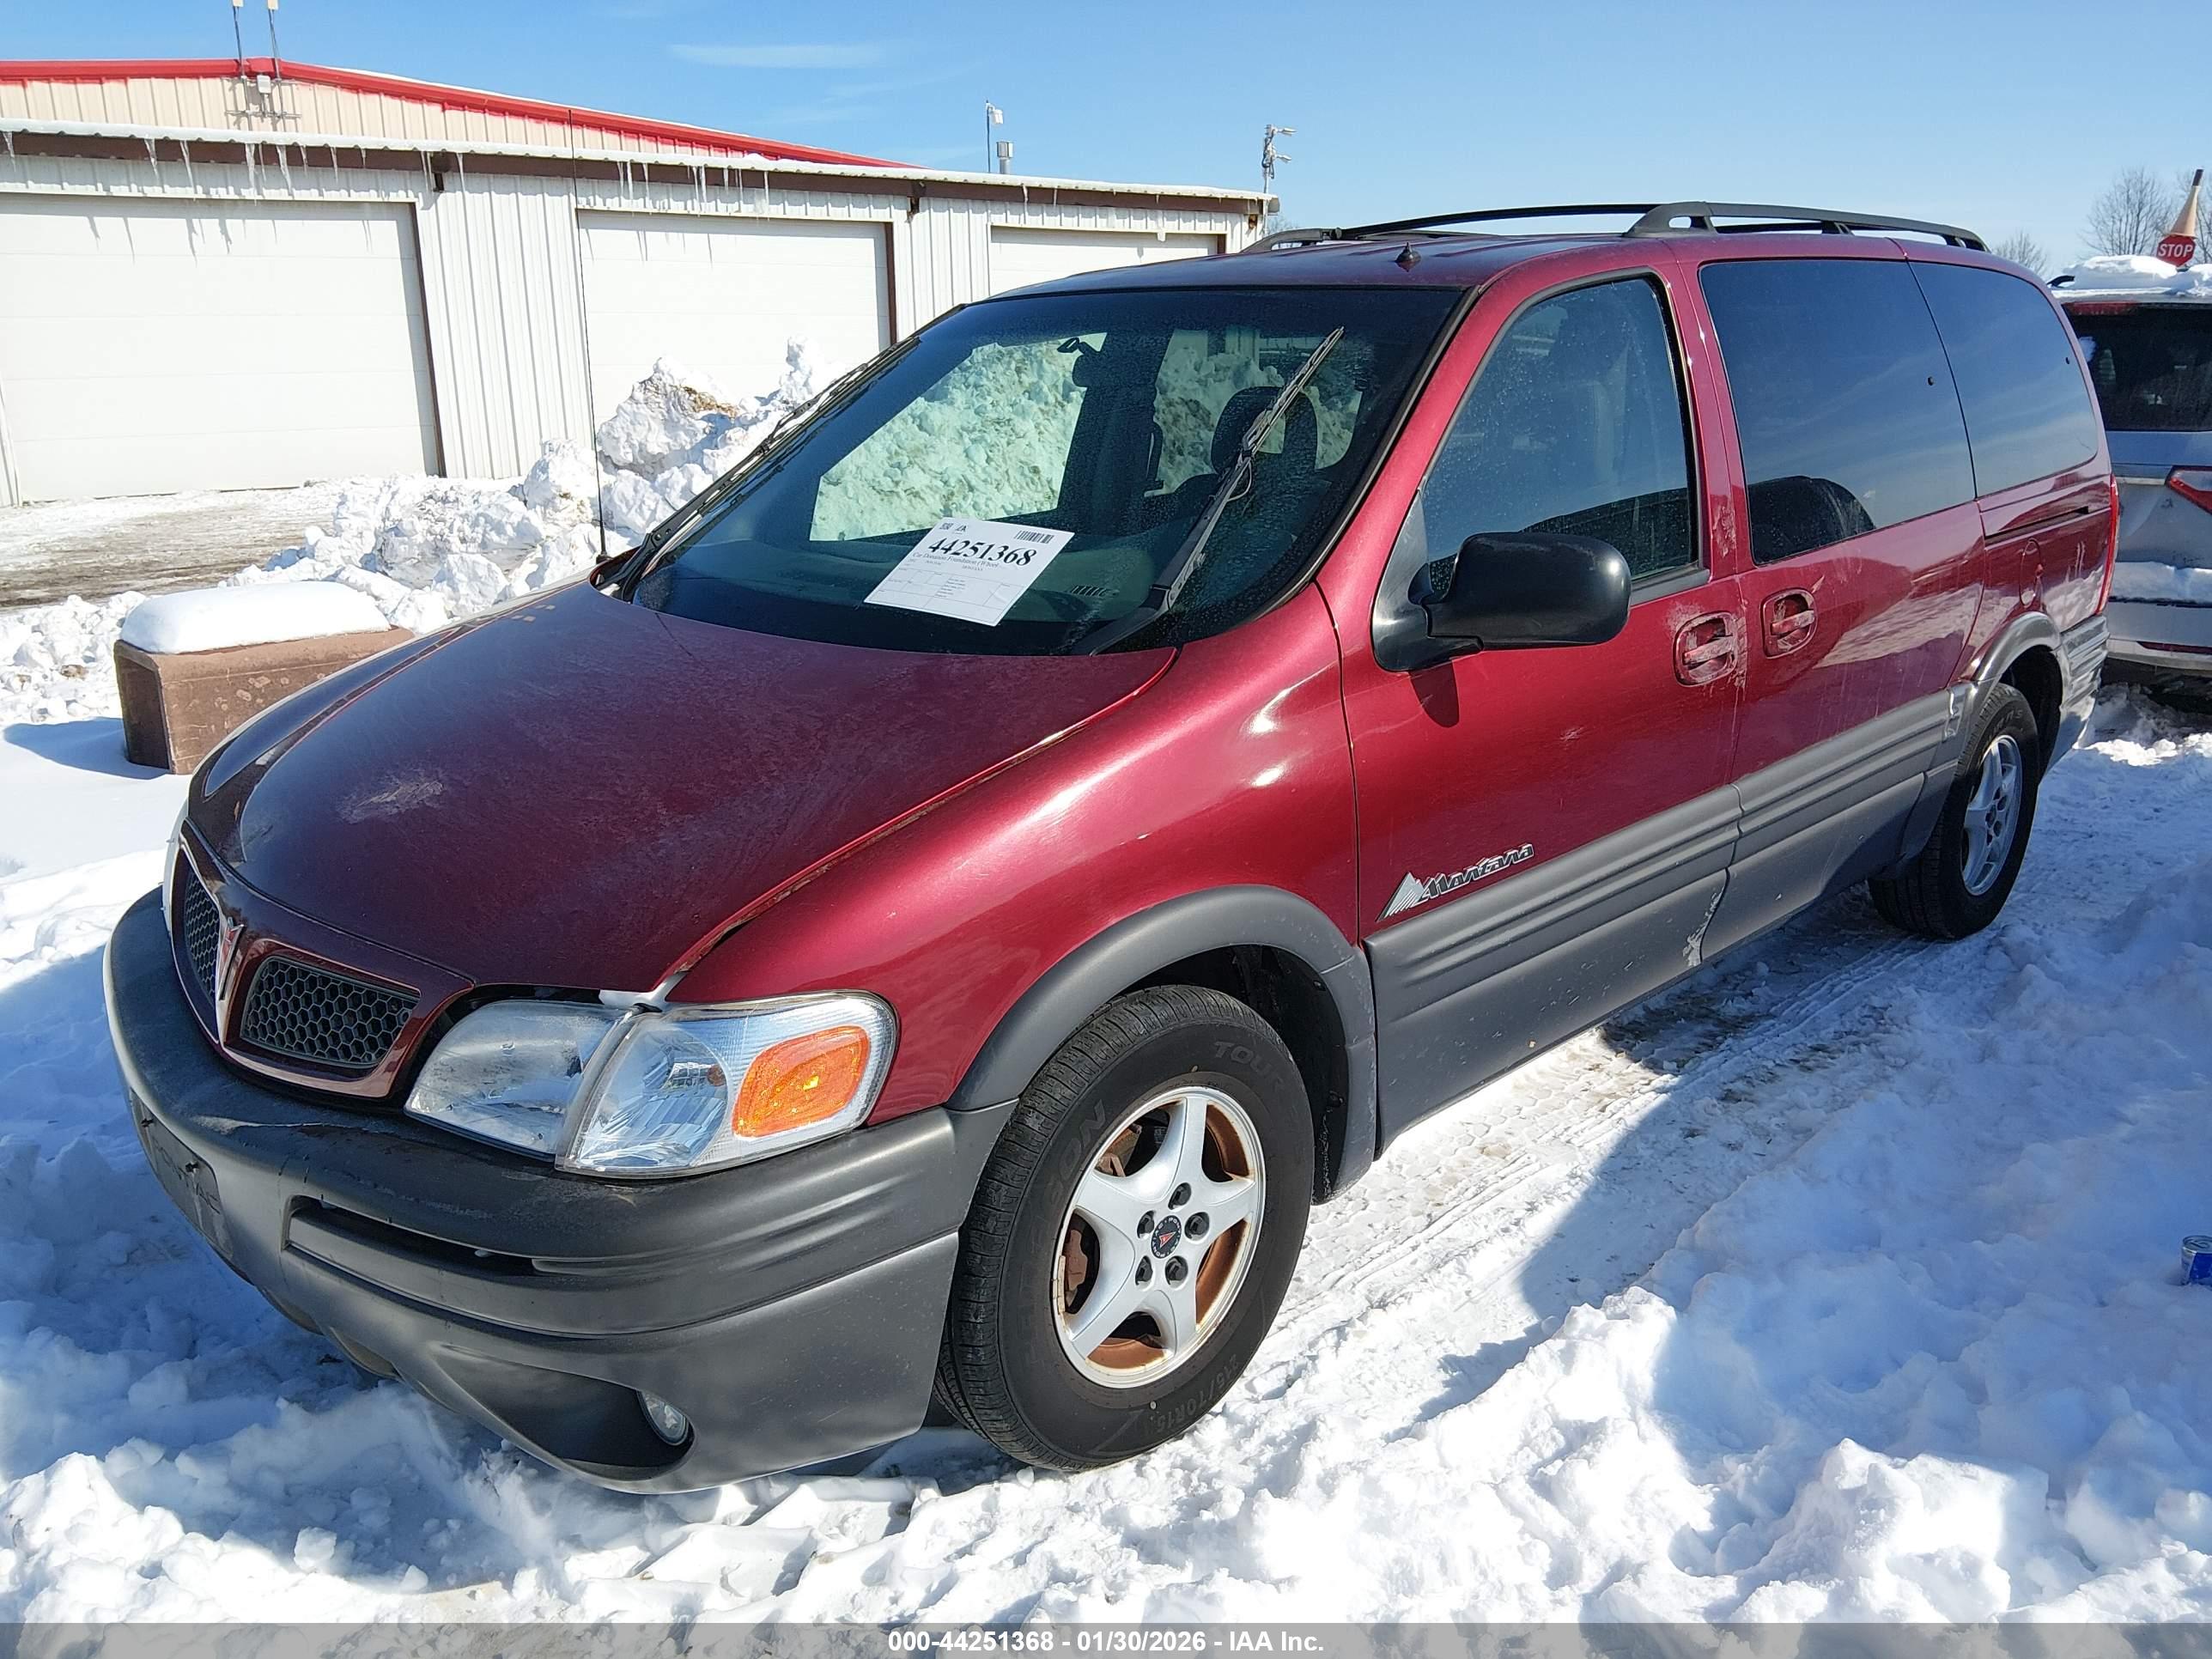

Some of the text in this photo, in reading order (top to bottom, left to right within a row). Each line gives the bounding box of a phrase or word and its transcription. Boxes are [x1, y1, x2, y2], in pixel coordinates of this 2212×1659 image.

[2158, 243, 2194, 258] STOP
[928, 537, 1037, 567] 44251368
[1418, 843, 1535, 902] Montana
